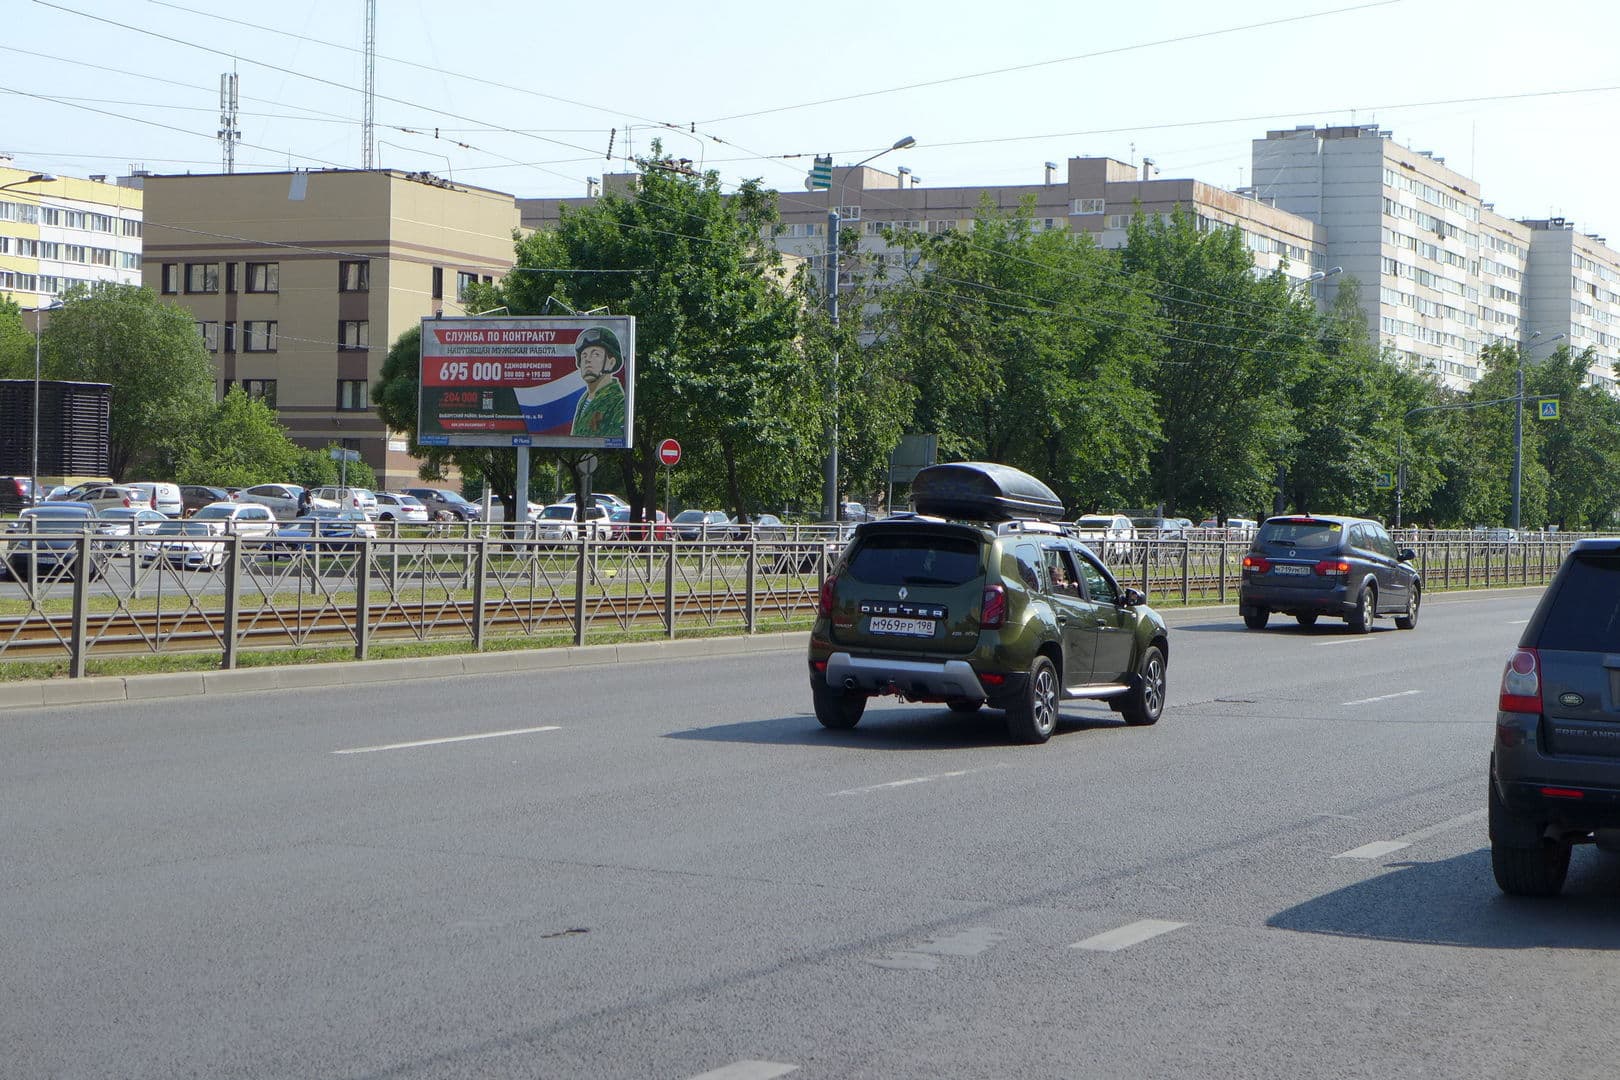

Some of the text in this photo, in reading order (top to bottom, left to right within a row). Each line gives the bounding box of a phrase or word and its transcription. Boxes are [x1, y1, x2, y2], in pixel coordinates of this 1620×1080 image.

[445, 331, 556, 342] СЛУЖБА ПО КОНТРАКТУ
[447, 346, 556, 355] НАСТОЯЩАЯ МУЖСКАЯ РАБОТА
[439, 362, 502, 381] 695 000
[444, 392, 460, 402] 204
[462, 392, 478, 402] 000
[861, 605, 942, 616] DUSTER
[872, 619, 932, 632] М969РР 198
